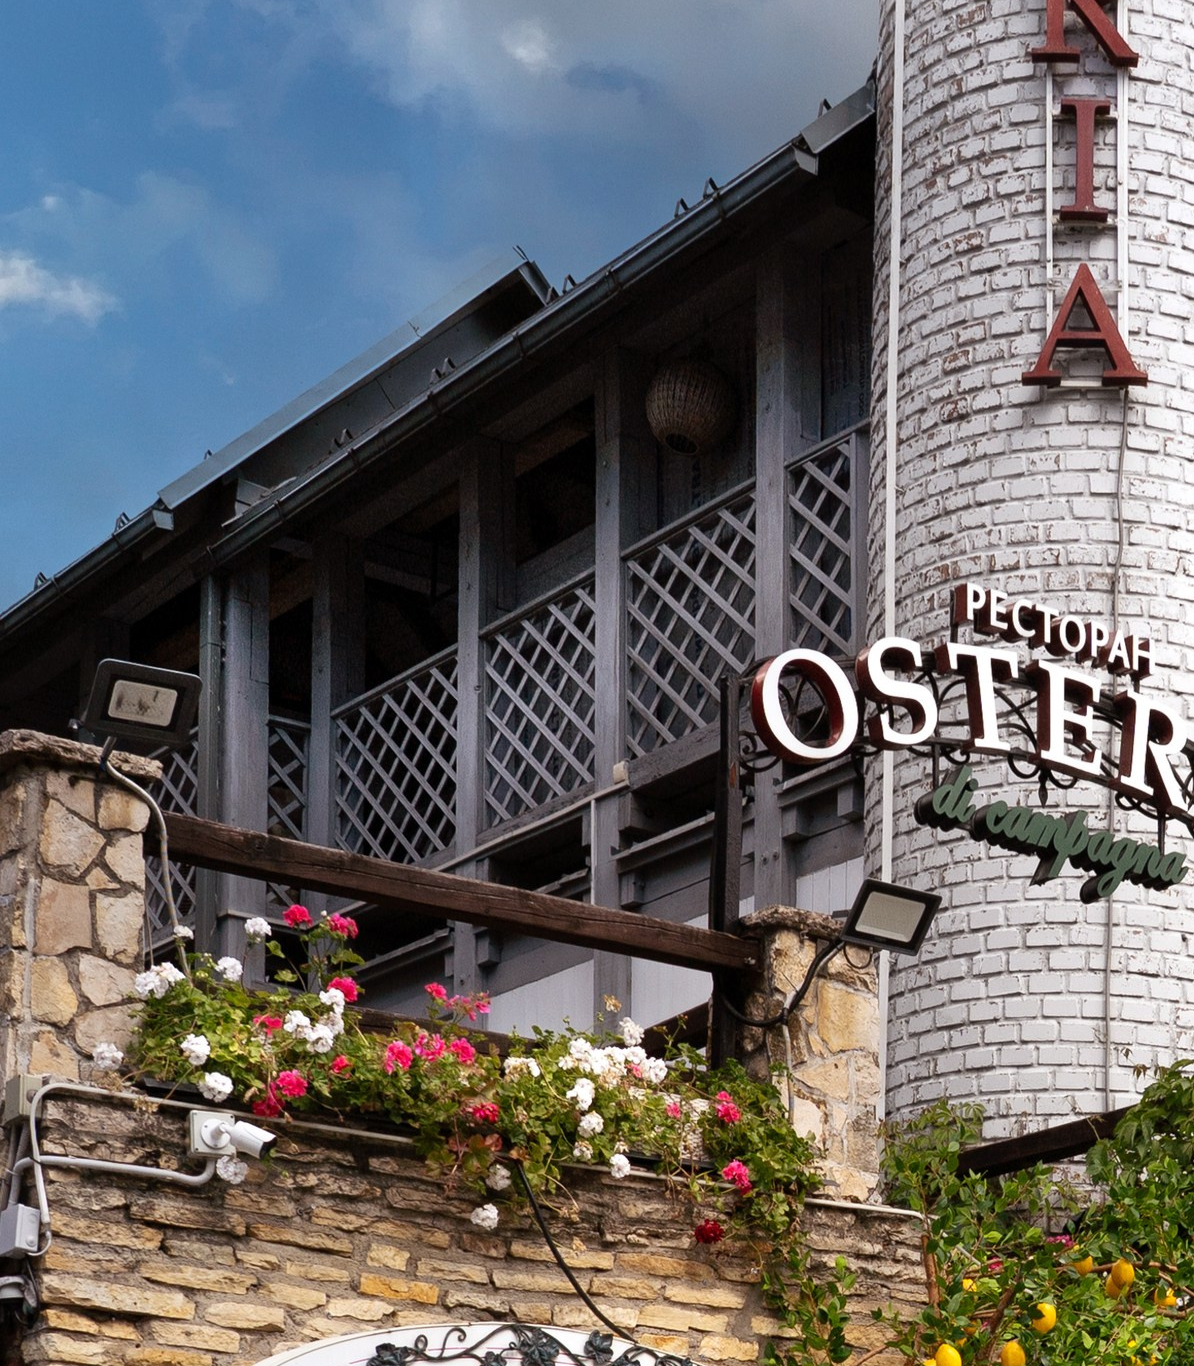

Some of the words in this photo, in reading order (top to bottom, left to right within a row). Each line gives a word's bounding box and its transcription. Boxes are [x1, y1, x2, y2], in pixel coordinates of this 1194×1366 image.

[965, 582, 1156, 675] РЕСТОРАН
[932, 766, 979, 823] di
[986, 800, 1189, 898] campagna
